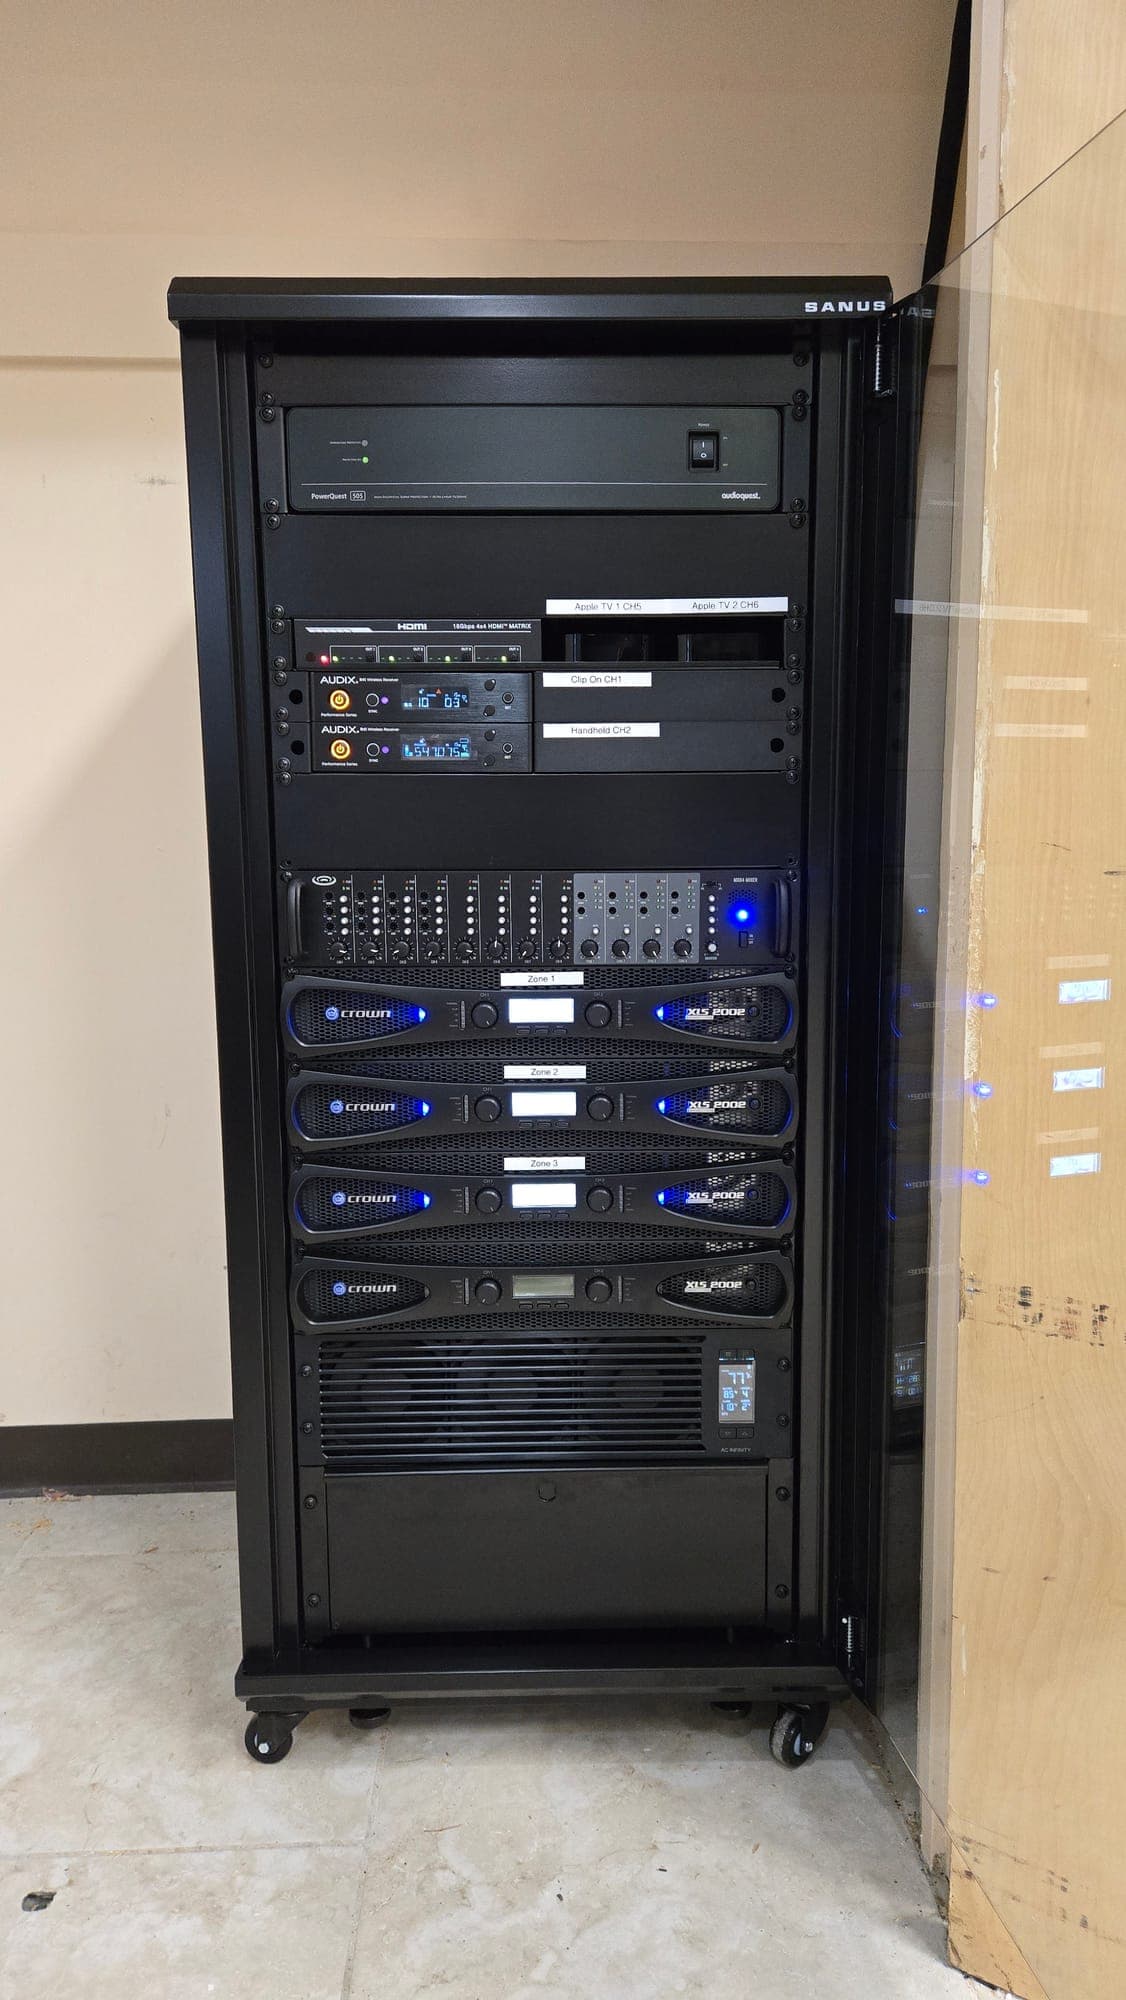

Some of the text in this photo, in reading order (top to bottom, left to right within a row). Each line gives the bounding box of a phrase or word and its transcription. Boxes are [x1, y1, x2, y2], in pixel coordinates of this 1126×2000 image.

[804, 301, 886, 313] SANUS
[311, 492, 347, 500] PowerQuest
[575, 603, 599, 611] Apple
[622, 603, 642, 611] CH5
[692, 601, 759, 610] Apple TV 2 CH6
[571, 675, 622, 684] Clip On CH1
[612, 726, 632, 734] CH2
[527, 975, 548, 983] Zone
[686, 1008, 745, 1016] XLS 2002
[530, 1068, 559, 1076] Zone 2
[687, 1100, 747, 1109] XLS 2002
[686, 1191, 745, 1199] XLS 2002
[685, 1281, 743, 1289] XLS 2002
[728, 1372, 745, 1385] 77
